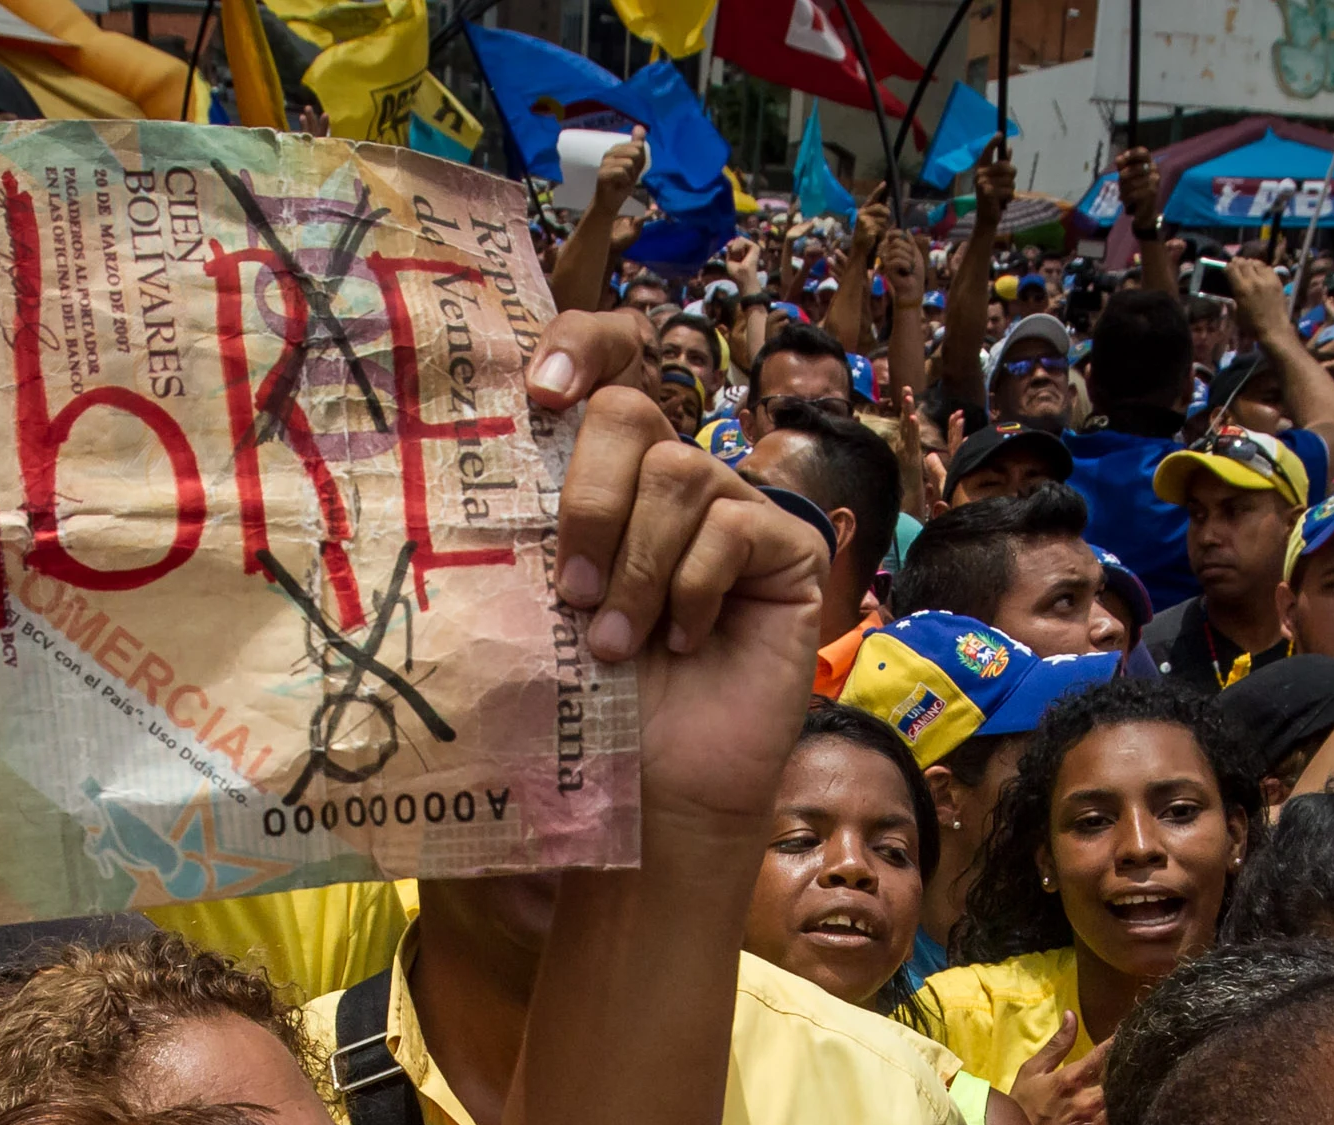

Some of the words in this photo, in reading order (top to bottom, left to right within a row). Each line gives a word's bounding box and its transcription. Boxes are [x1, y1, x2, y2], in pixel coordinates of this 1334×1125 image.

[45, 166, 60, 190] EN
[93, 169, 109, 189] 20
[48, 191, 64, 224] LAS
[63, 166, 87, 262] PAGADEROS
[97, 192, 113, 217] DE
[164, 165, 207, 265] CIEN
[412, 194, 461, 246] de
[75, 263, 89, 284] AL
[100, 223, 122, 288] MARZO
[122, 166, 186, 399] BOLÍVARES
[61, 302, 77, 335] DEL
[109, 290, 124, 316] DE
[76, 287, 101, 376] PORTADOR
[112, 317, 131, 354] 2007
[65, 337, 85, 395] BANCO
[432, 271, 518, 524] Venezuela
[0, 630, 19, 669] BCV
[21, 620, 56, 652] BCV
[54, 648, 85, 680] con
[83, 669, 104, 692] el
[146, 718, 179, 751] Uso
[175, 741, 250, 809] Didáctico.
[906, 704, 926, 720] UN
[907, 699, 944, 739] CAMINO
